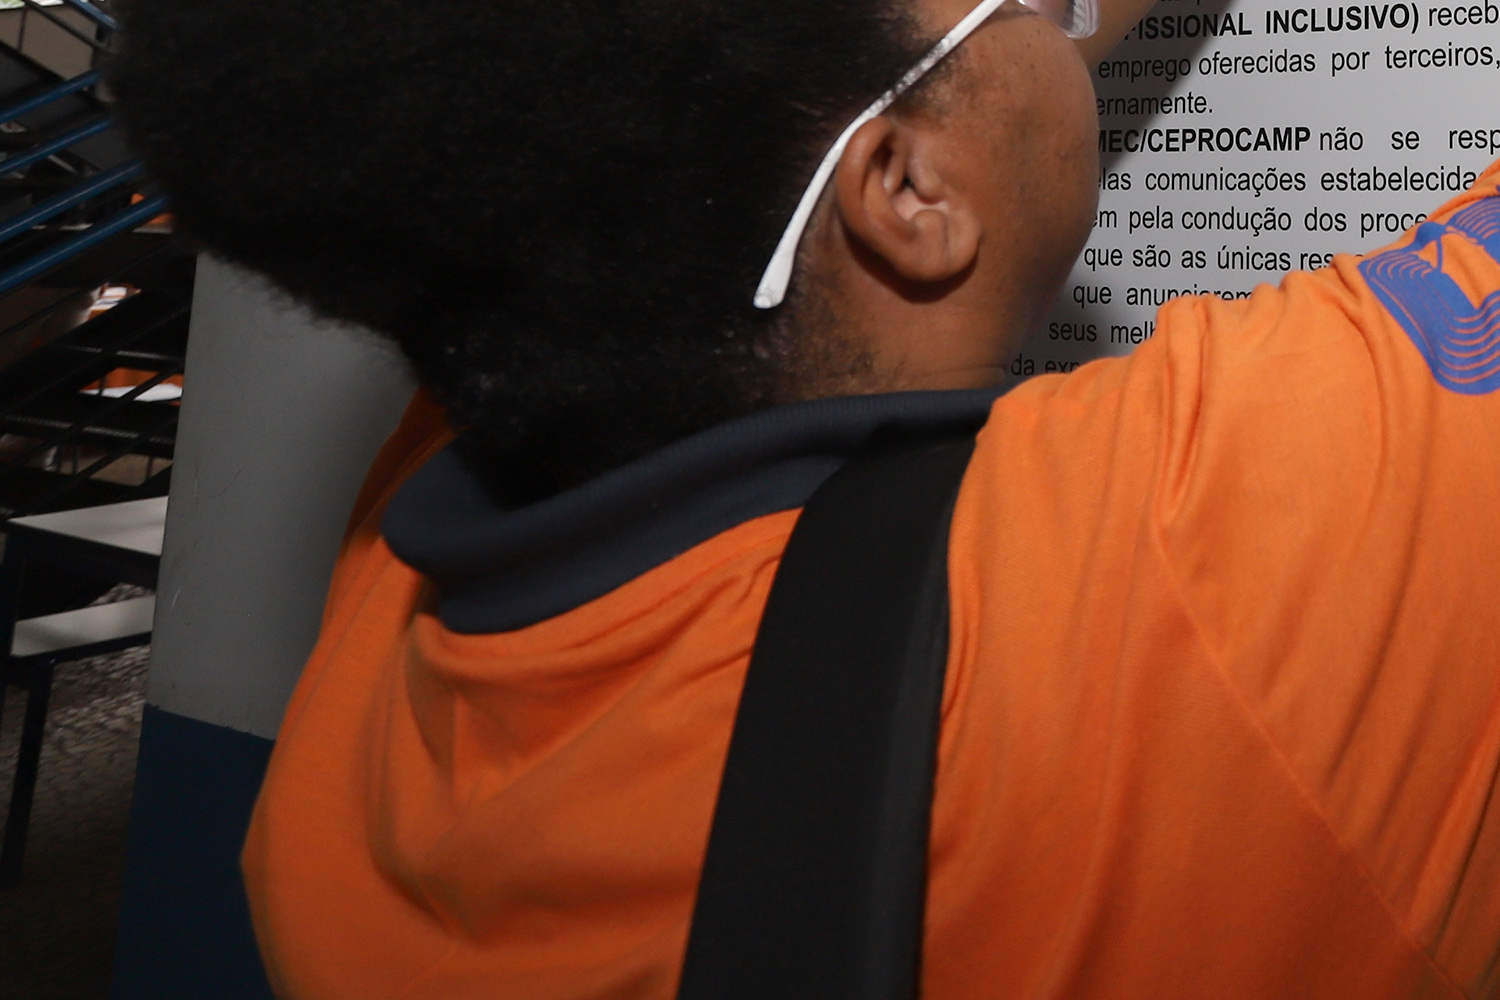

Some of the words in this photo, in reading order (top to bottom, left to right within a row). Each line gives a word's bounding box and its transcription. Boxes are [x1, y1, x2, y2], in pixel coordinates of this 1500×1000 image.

[1265, 2, 1420, 36] INCLUSIVO)
[1199, 46, 1316, 76] oferecidas
[1331, 48, 1370, 75] por
[1385, 44, 1500, 72] terceiros,
[1319, 127, 1364, 152] não
[1391, 130, 1421, 151] se
[1145, 167, 1306, 198] comunicações
